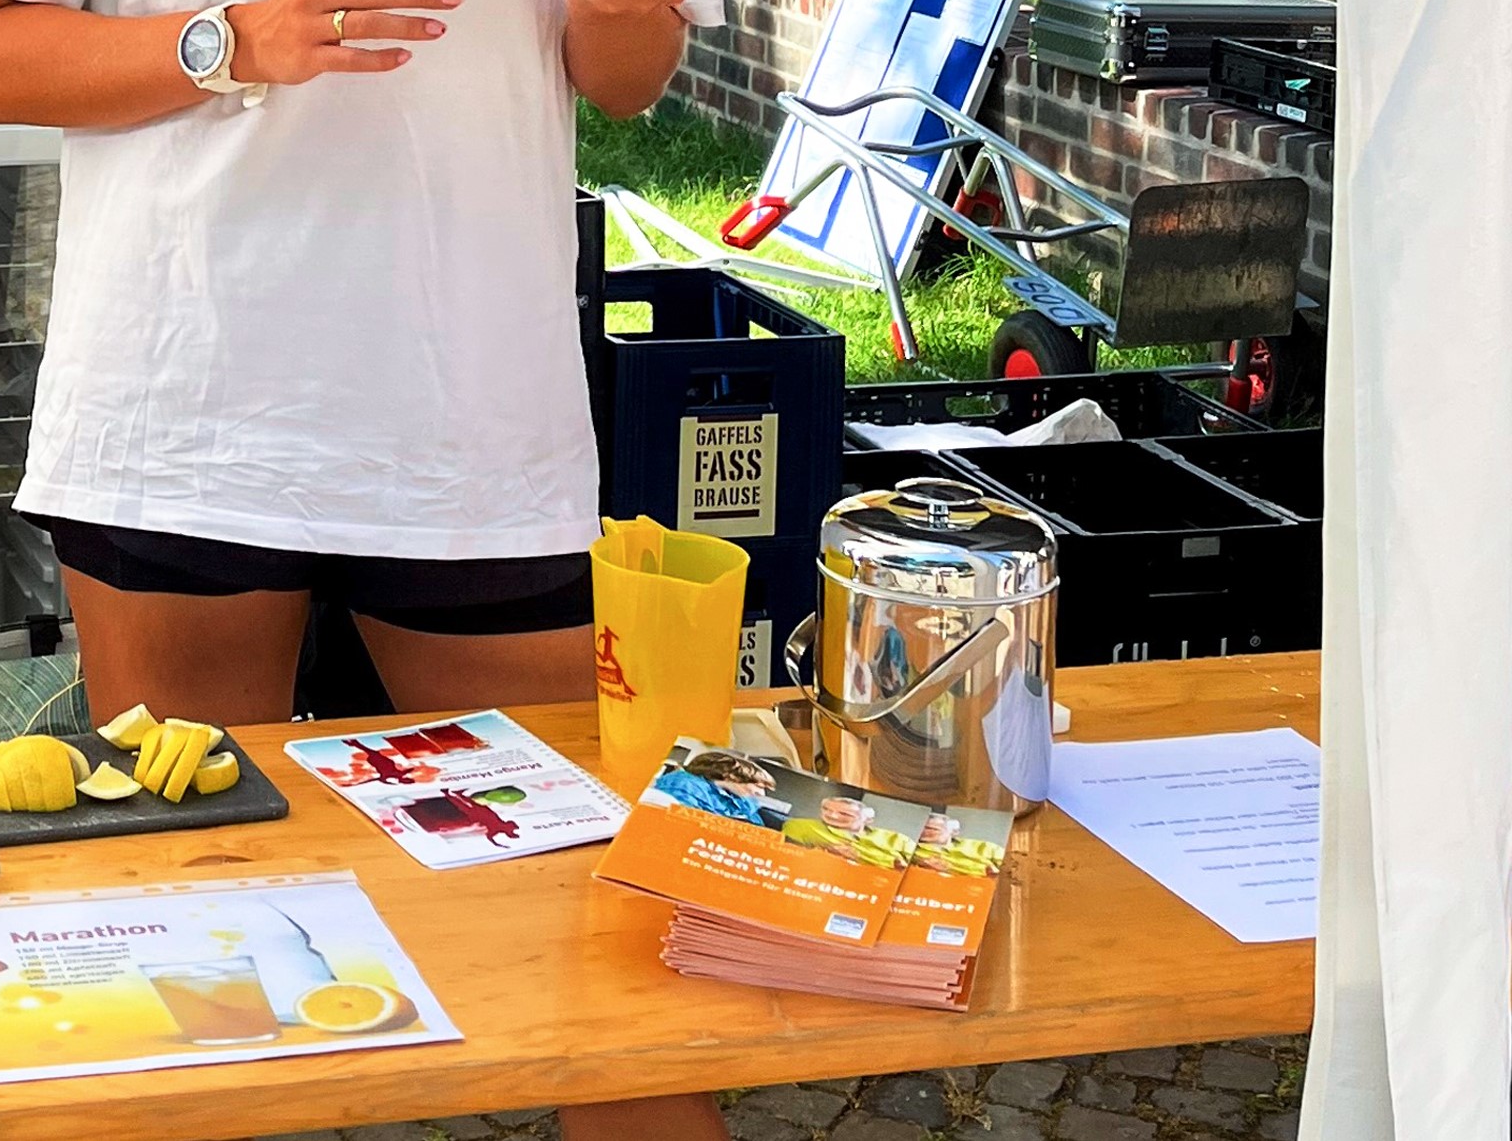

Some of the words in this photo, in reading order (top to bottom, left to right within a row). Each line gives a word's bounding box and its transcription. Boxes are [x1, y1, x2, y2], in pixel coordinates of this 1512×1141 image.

[696, 425, 763, 446] GAFFELS
[694, 449, 762, 483] FASS
[693, 485, 761, 508] BRAUSE
[692, 838, 772, 868] Alkohol
[688, 846, 749, 871] reden
[754, 866, 790, 882] wir
[793, 876, 878, 904] drüber!
[9, 923, 168, 944] Marathon
